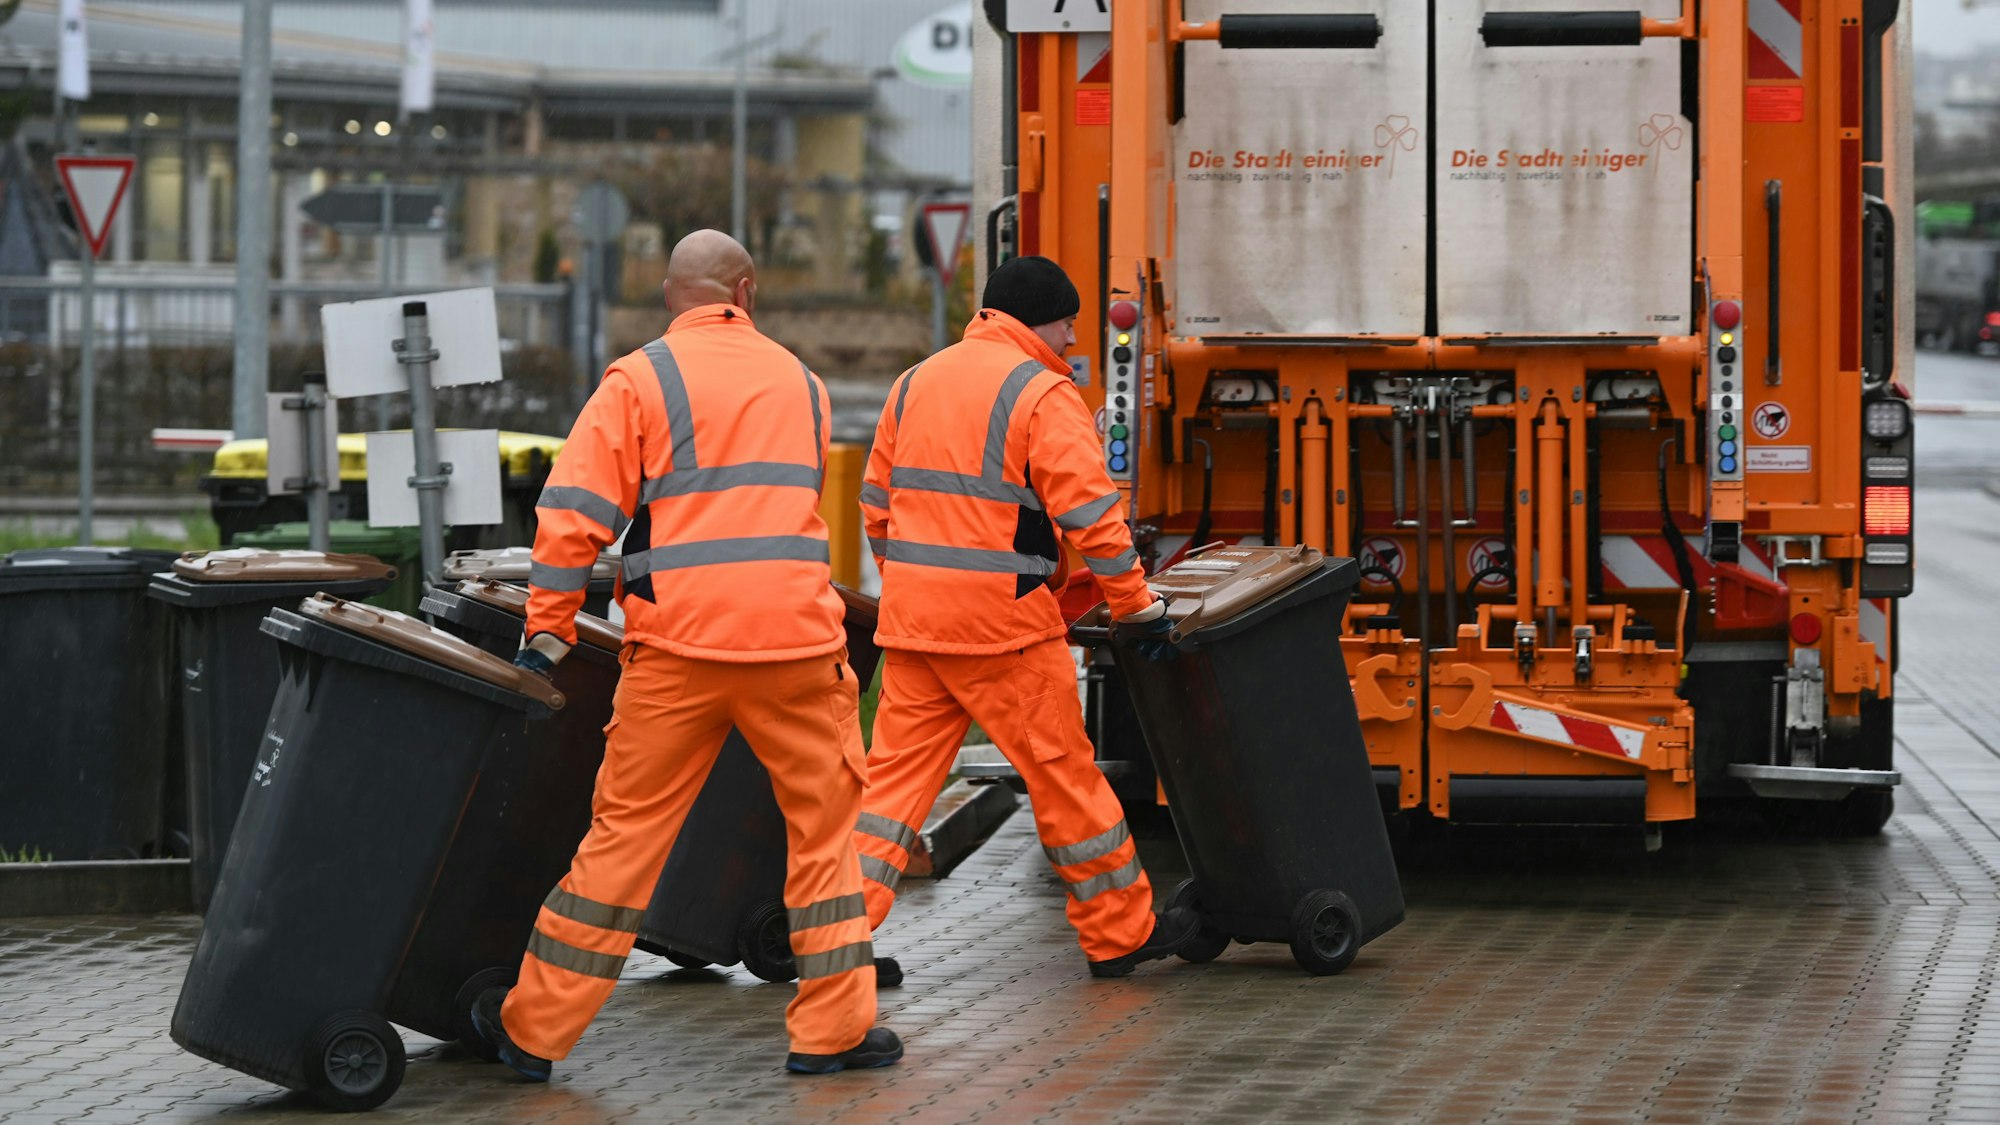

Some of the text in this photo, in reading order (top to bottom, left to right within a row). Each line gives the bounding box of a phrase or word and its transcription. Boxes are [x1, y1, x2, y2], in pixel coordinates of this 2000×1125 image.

[932, 21, 973, 49] D
[1188, 148, 1385, 172] Die Stadteinier
[1451, 147, 1648, 172] Die Sadtreiniger
